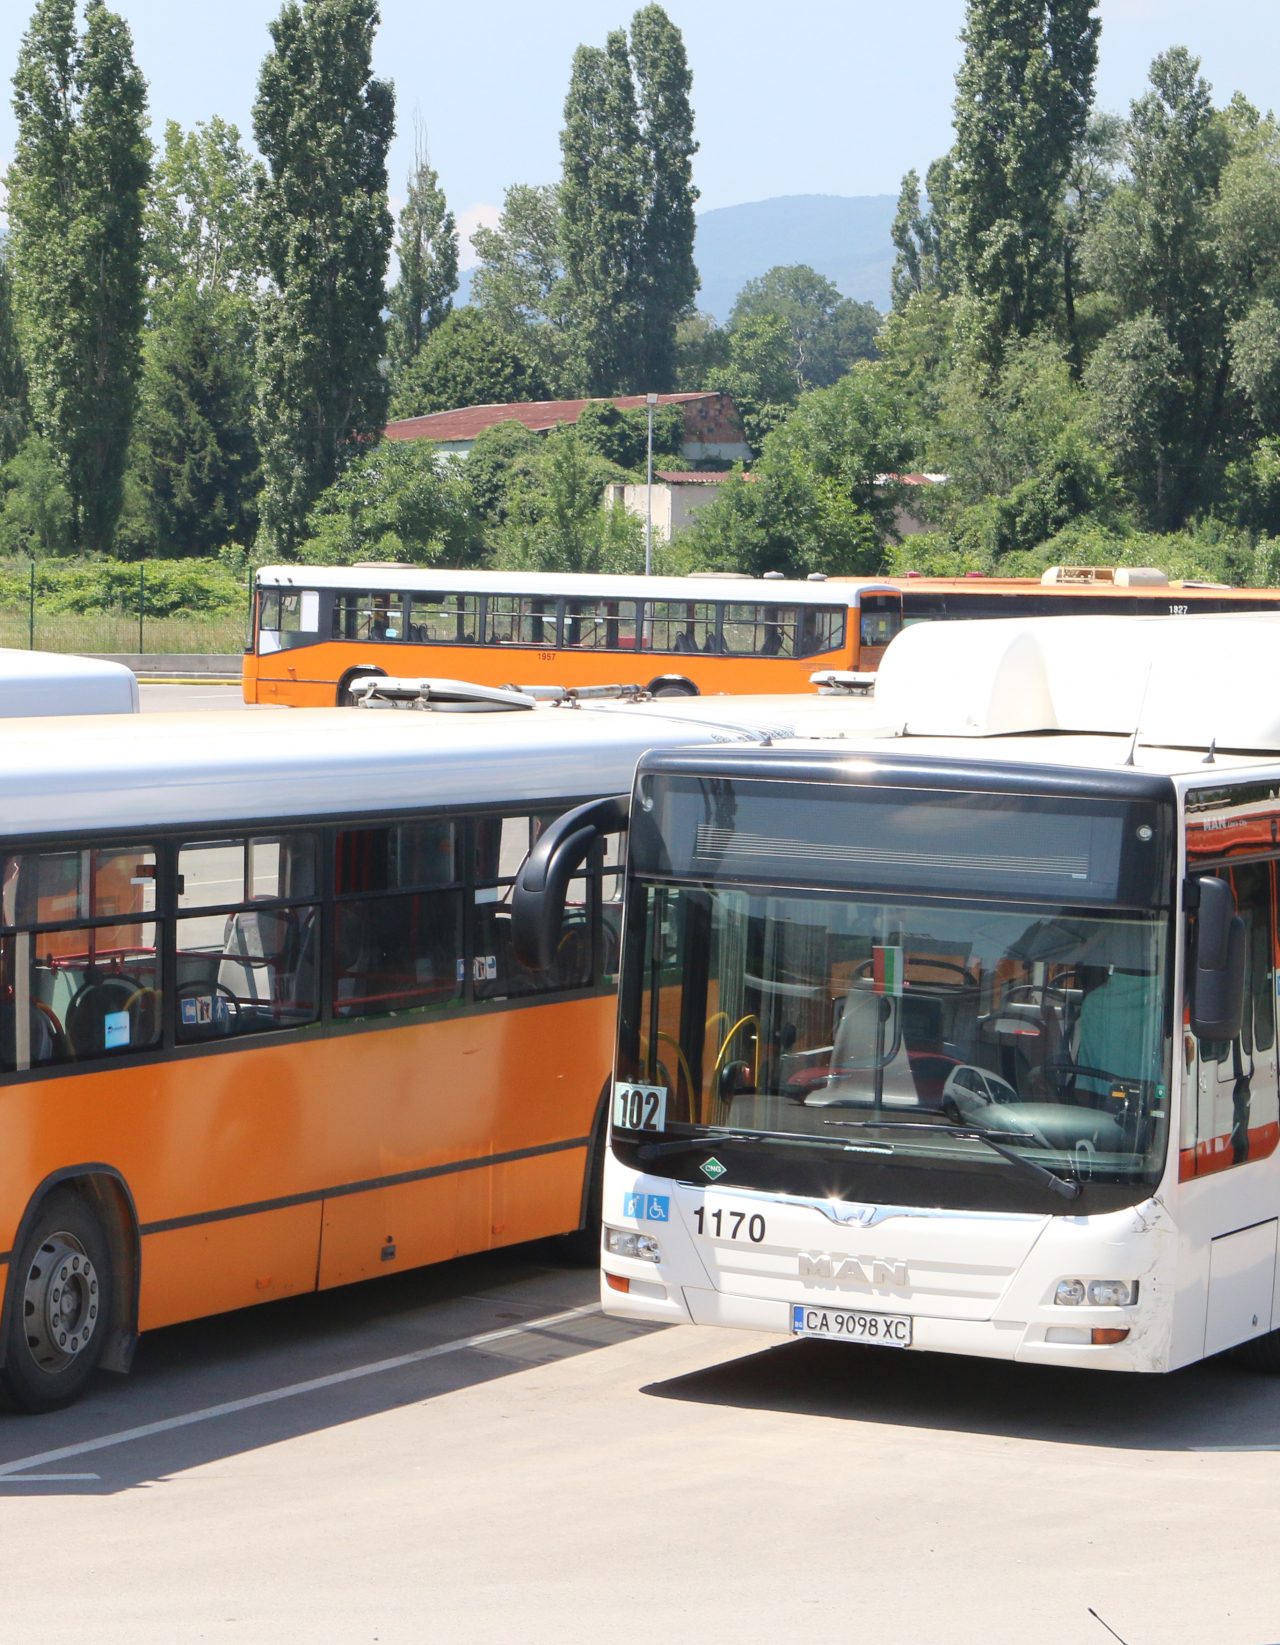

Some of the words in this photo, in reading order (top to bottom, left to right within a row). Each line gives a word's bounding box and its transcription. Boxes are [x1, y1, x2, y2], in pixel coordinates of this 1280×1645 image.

[538, 652, 556, 661] 1957
[620, 1089, 660, 1131] 102
[704, 1163, 722, 1174] CNG
[693, 1206, 766, 1243] 1170
[798, 1252, 907, 1287] MAN
[806, 1311, 830, 1332] CA
[834, 1314, 879, 1337] 9098
